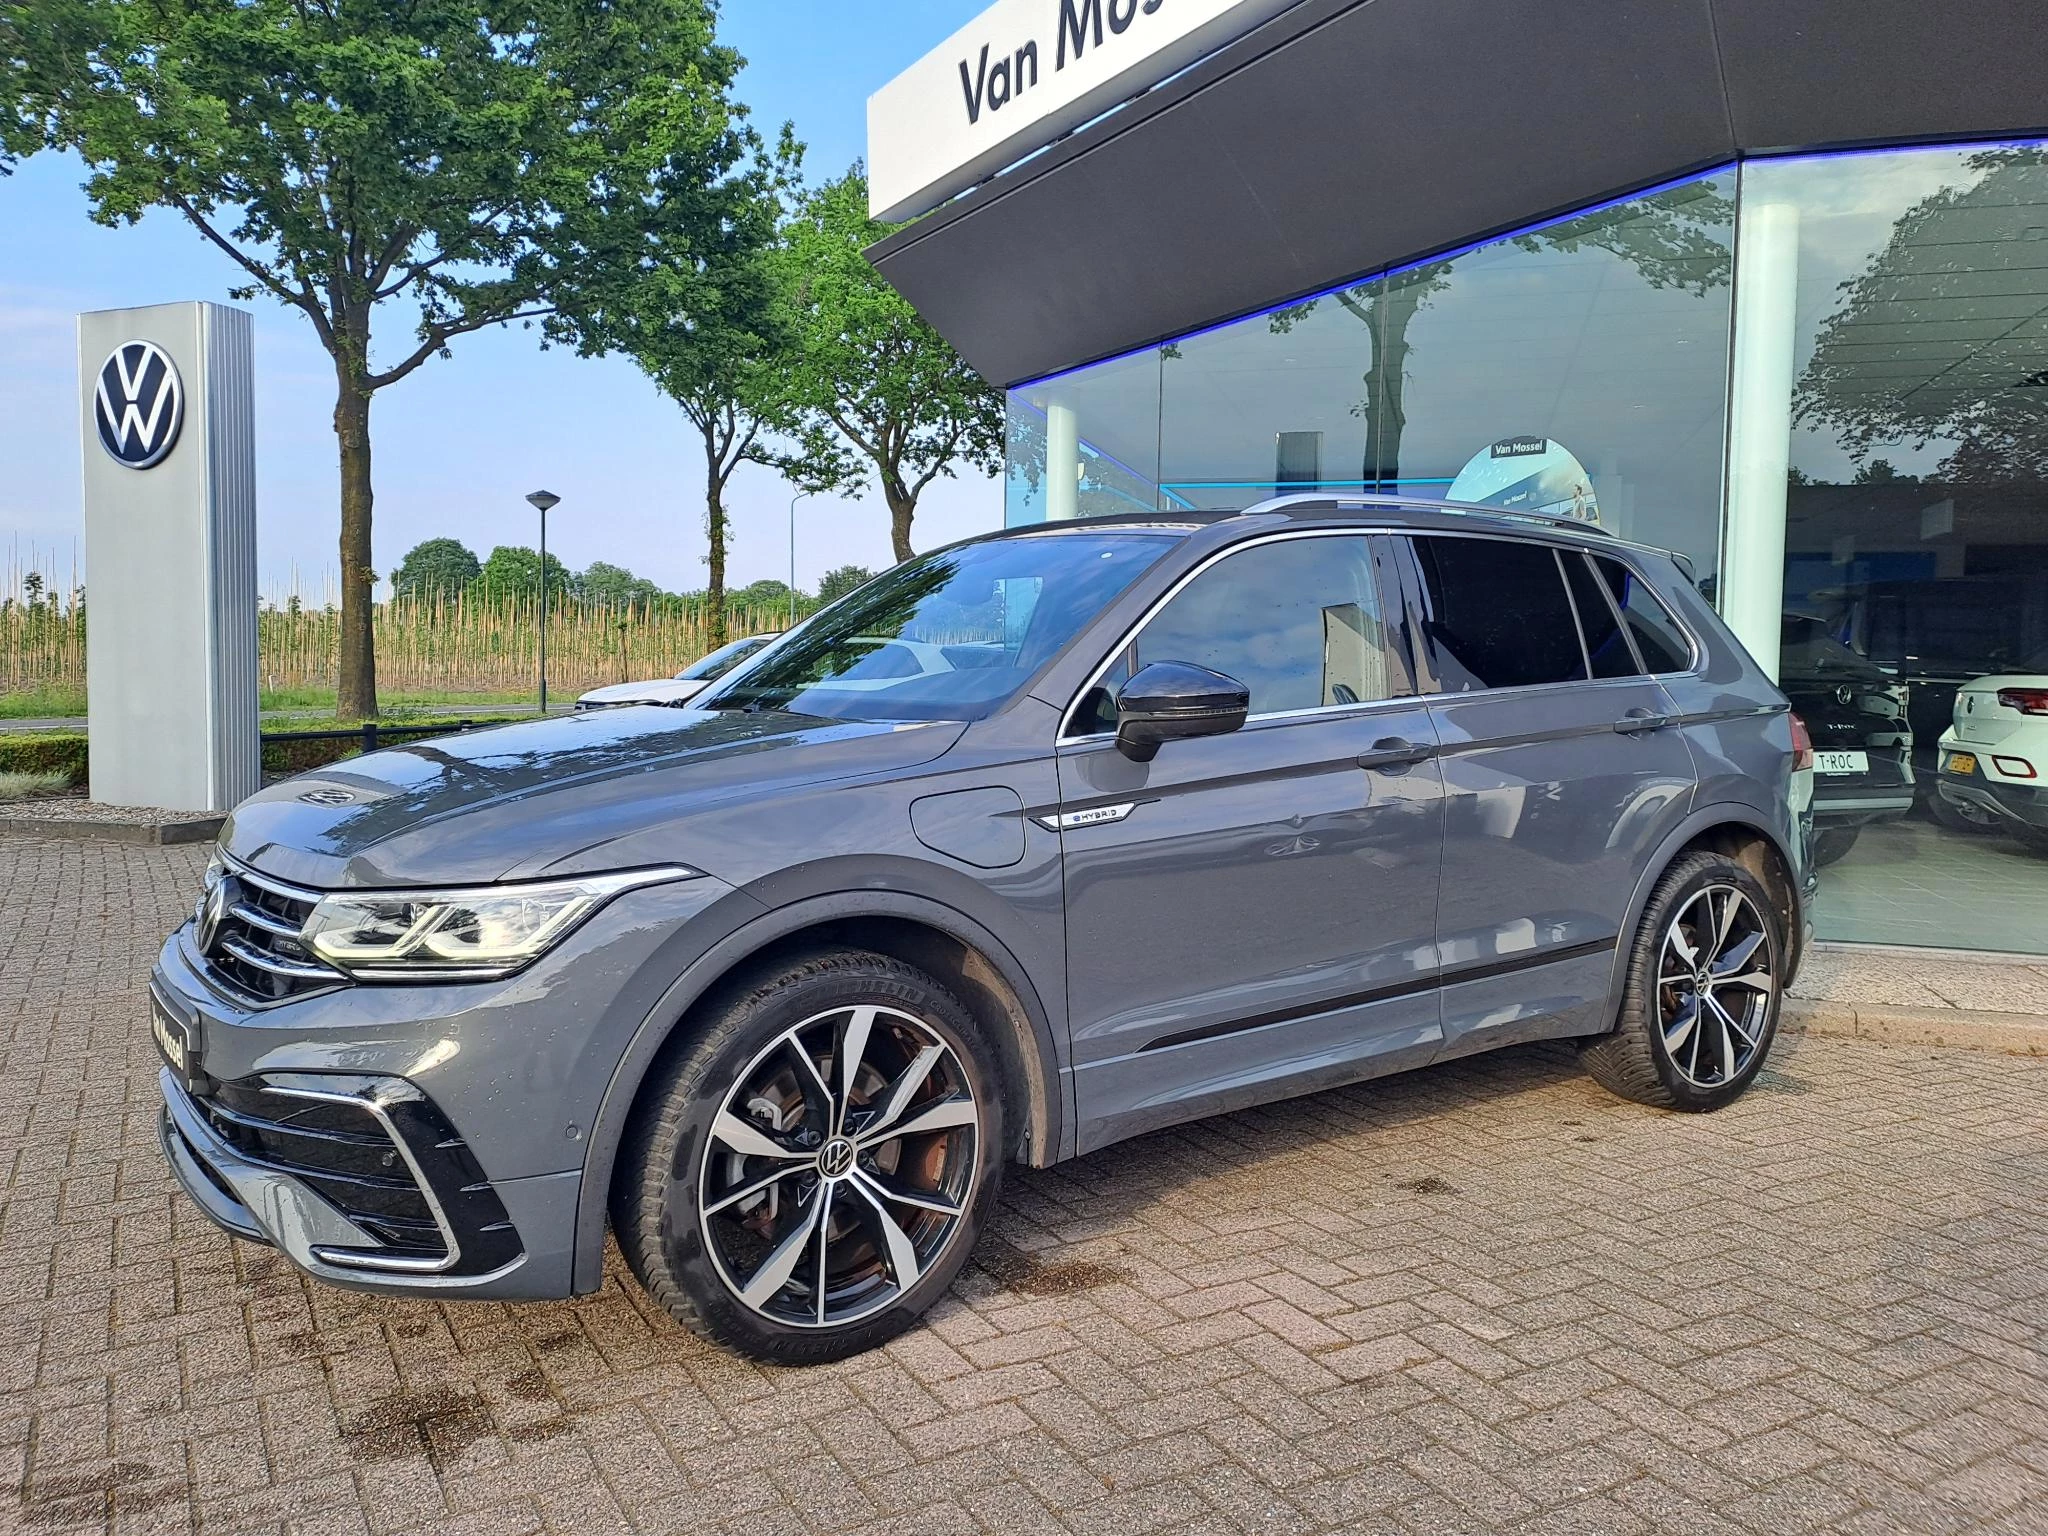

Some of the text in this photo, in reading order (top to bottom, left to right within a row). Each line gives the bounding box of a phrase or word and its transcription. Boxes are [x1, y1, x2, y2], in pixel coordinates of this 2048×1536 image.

[958, 0, 1164, 125] Van Mo
[1496, 440, 1543, 455] Van Mossel
[1819, 755, 1854, 769] T-ROC
